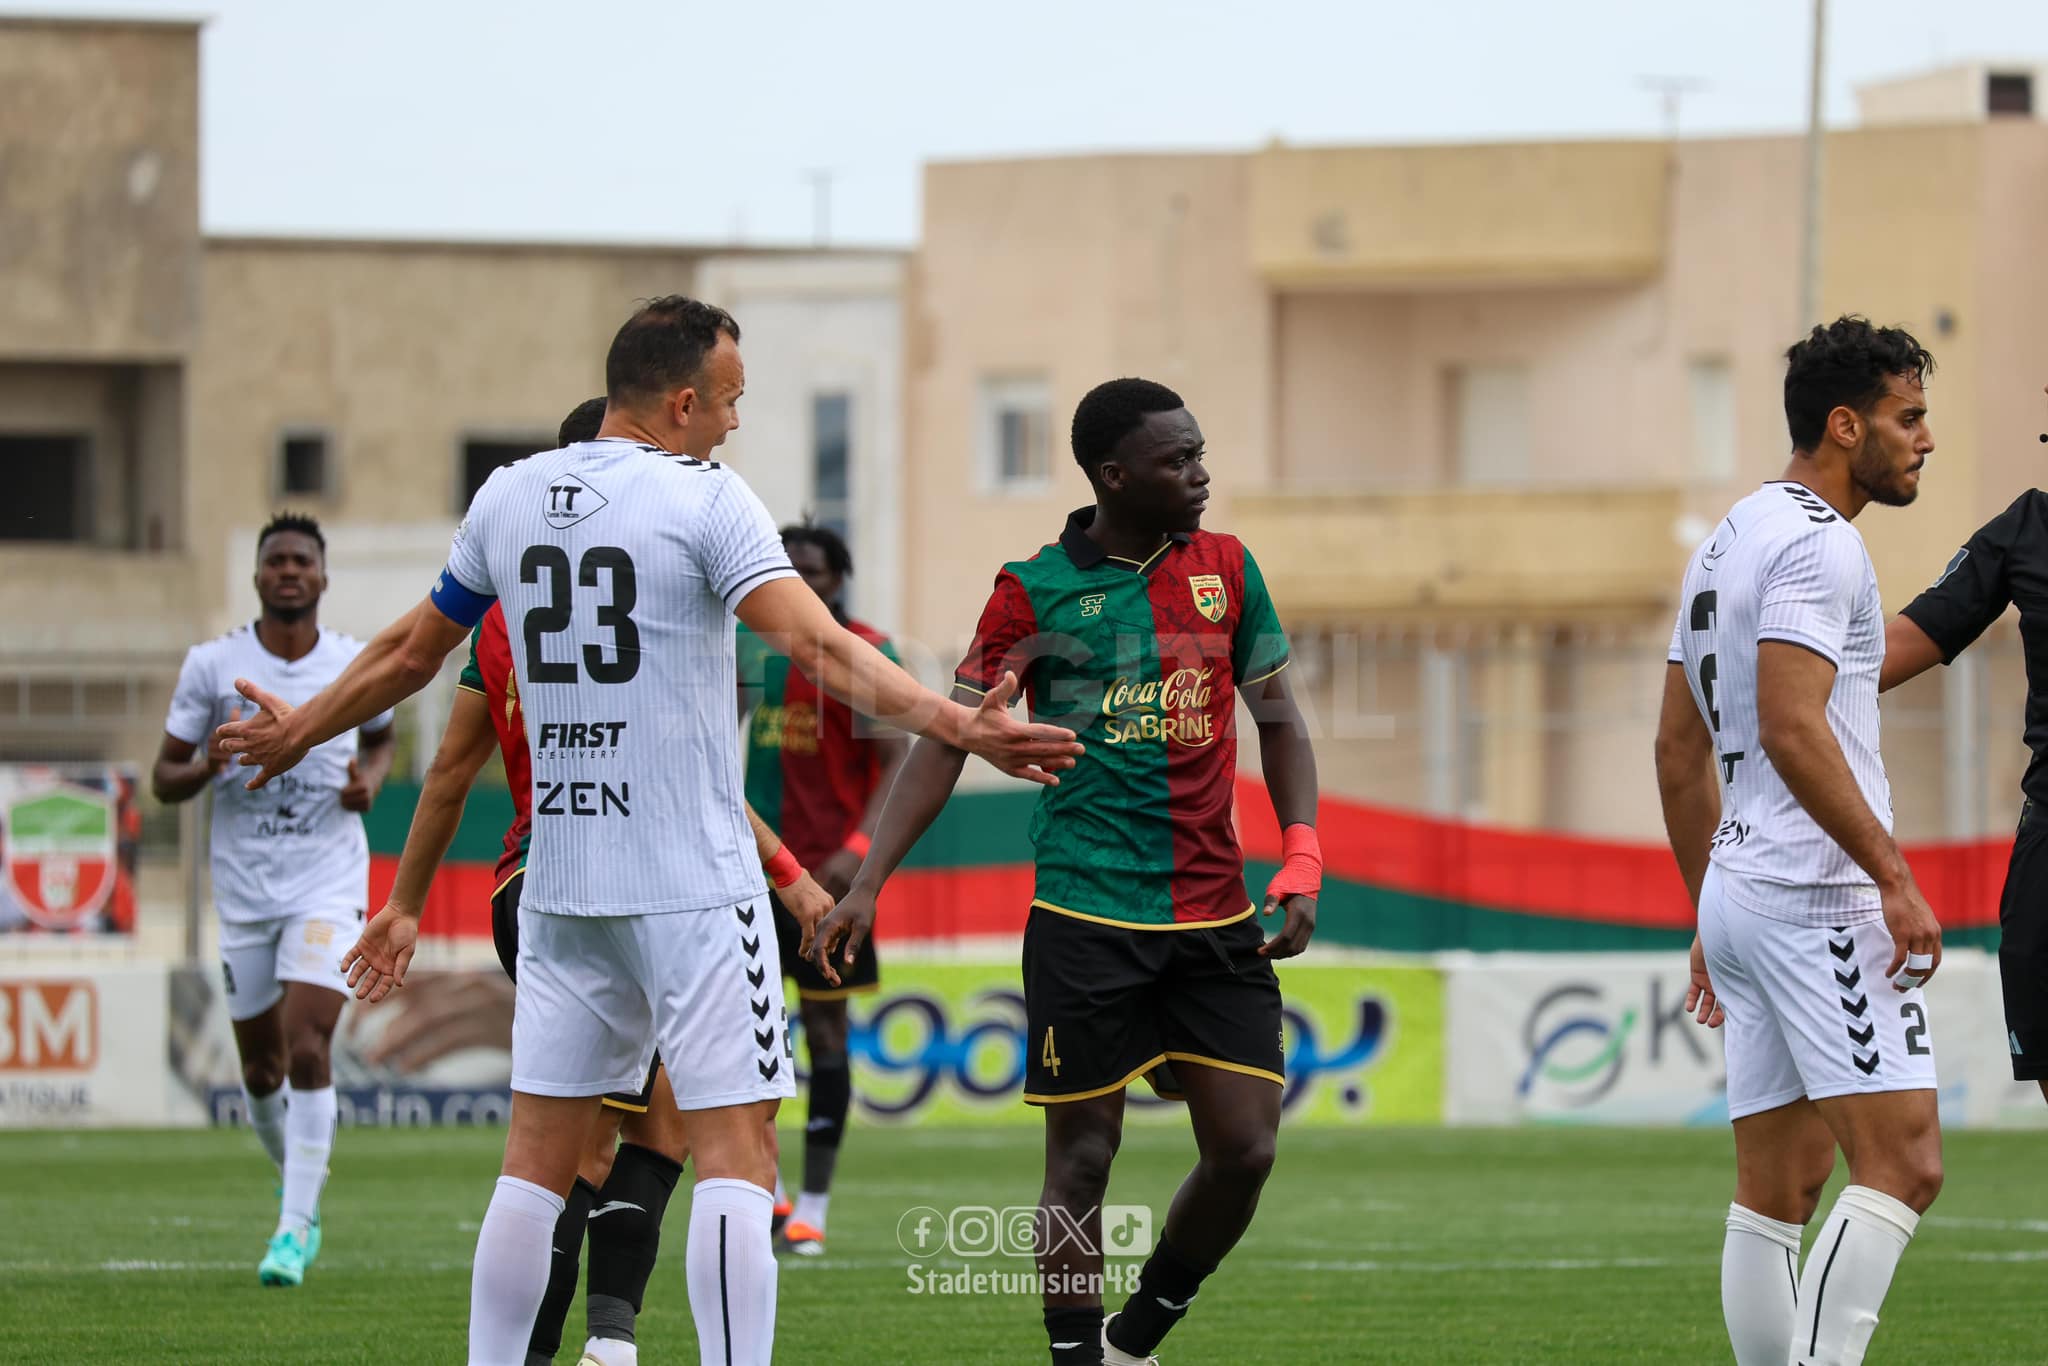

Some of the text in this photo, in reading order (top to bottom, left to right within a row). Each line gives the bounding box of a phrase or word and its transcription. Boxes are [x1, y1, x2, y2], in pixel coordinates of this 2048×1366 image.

[550, 485, 583, 511] TT
[520, 545, 641, 683] 23
[1102, 667, 1214, 716] Coca-Cola
[537, 750, 618, 760] DELIVERY
[538, 721, 627, 748] FIRST
[536, 781, 631, 818] ZEN
[1901, 1002, 1930, 1056] 2
[1042, 1025, 1061, 1078] 4
